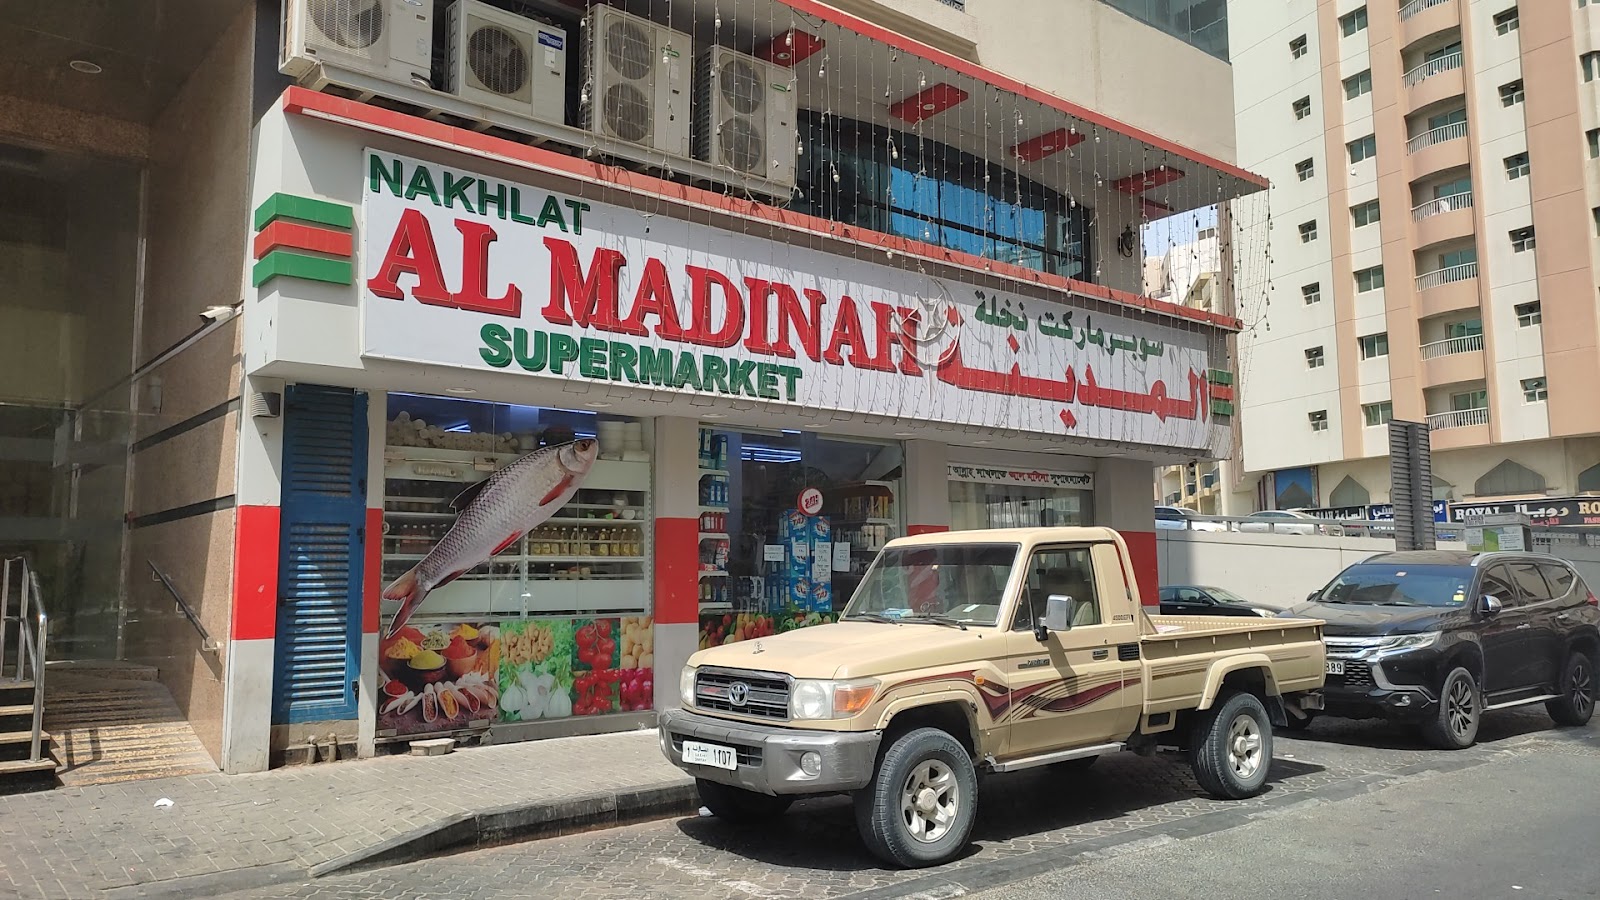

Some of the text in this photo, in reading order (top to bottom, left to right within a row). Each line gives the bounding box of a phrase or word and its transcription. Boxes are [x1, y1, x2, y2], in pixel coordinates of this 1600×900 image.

[369, 154, 590, 235] NAKHLAT
[367, 208, 924, 377] AL MADINAH
[974, 290, 1028, 331] نخلة
[478, 323, 803, 401] SUPERMARKET
[937, 306, 1207, 429] المدينة
[1454, 506, 1501, 520] ROYAL
